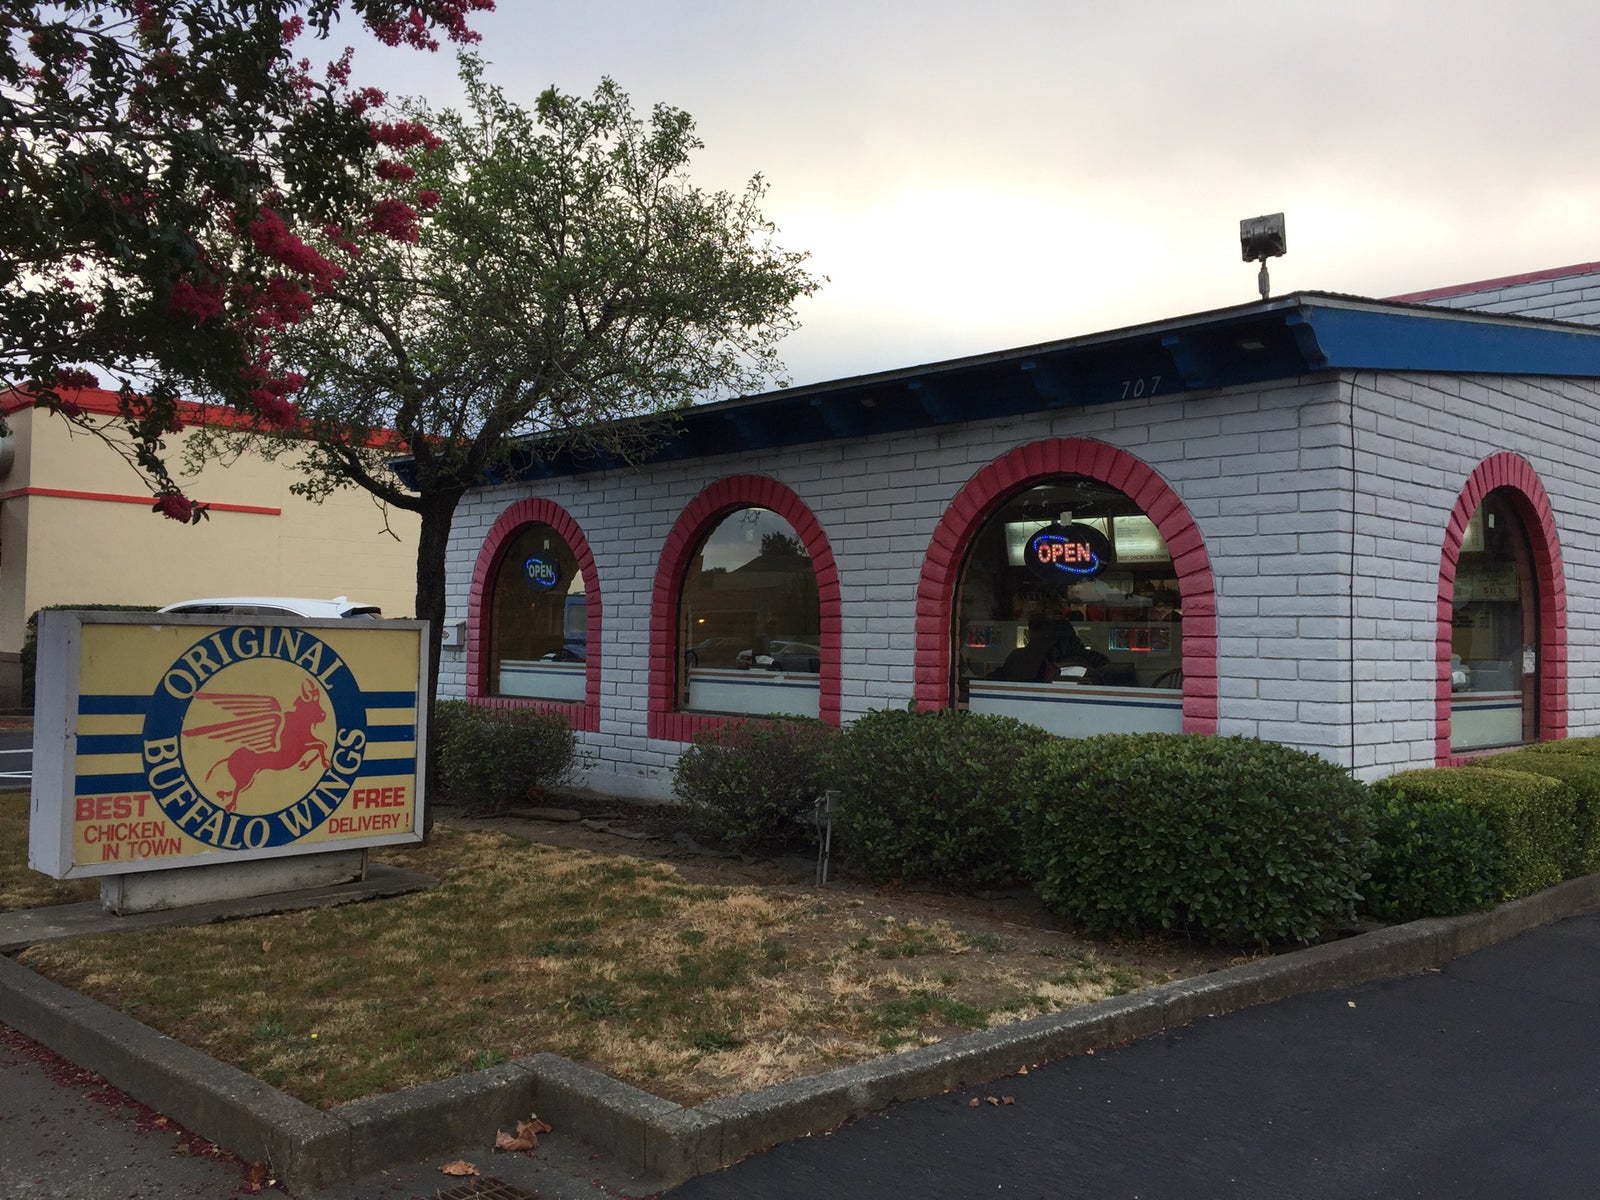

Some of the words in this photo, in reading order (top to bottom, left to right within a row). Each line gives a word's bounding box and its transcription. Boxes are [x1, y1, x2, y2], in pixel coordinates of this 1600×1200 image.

[1122, 376, 1161, 399] 707
[1038, 543, 1091, 563] OPEN
[529, 564, 552, 578] OPEN
[164, 626, 343, 699] ORIGINAL
[144, 735, 270, 849] BUFFALO
[278, 728, 367, 838] WINGS
[352, 786, 406, 809] FREE
[76, 794, 151, 821] BEST
[83, 820, 166, 844] CHICKEN
[328, 813, 401, 834] DELIVERY
[102, 842, 119, 861] IN
[127, 837, 182, 858] TOWN
